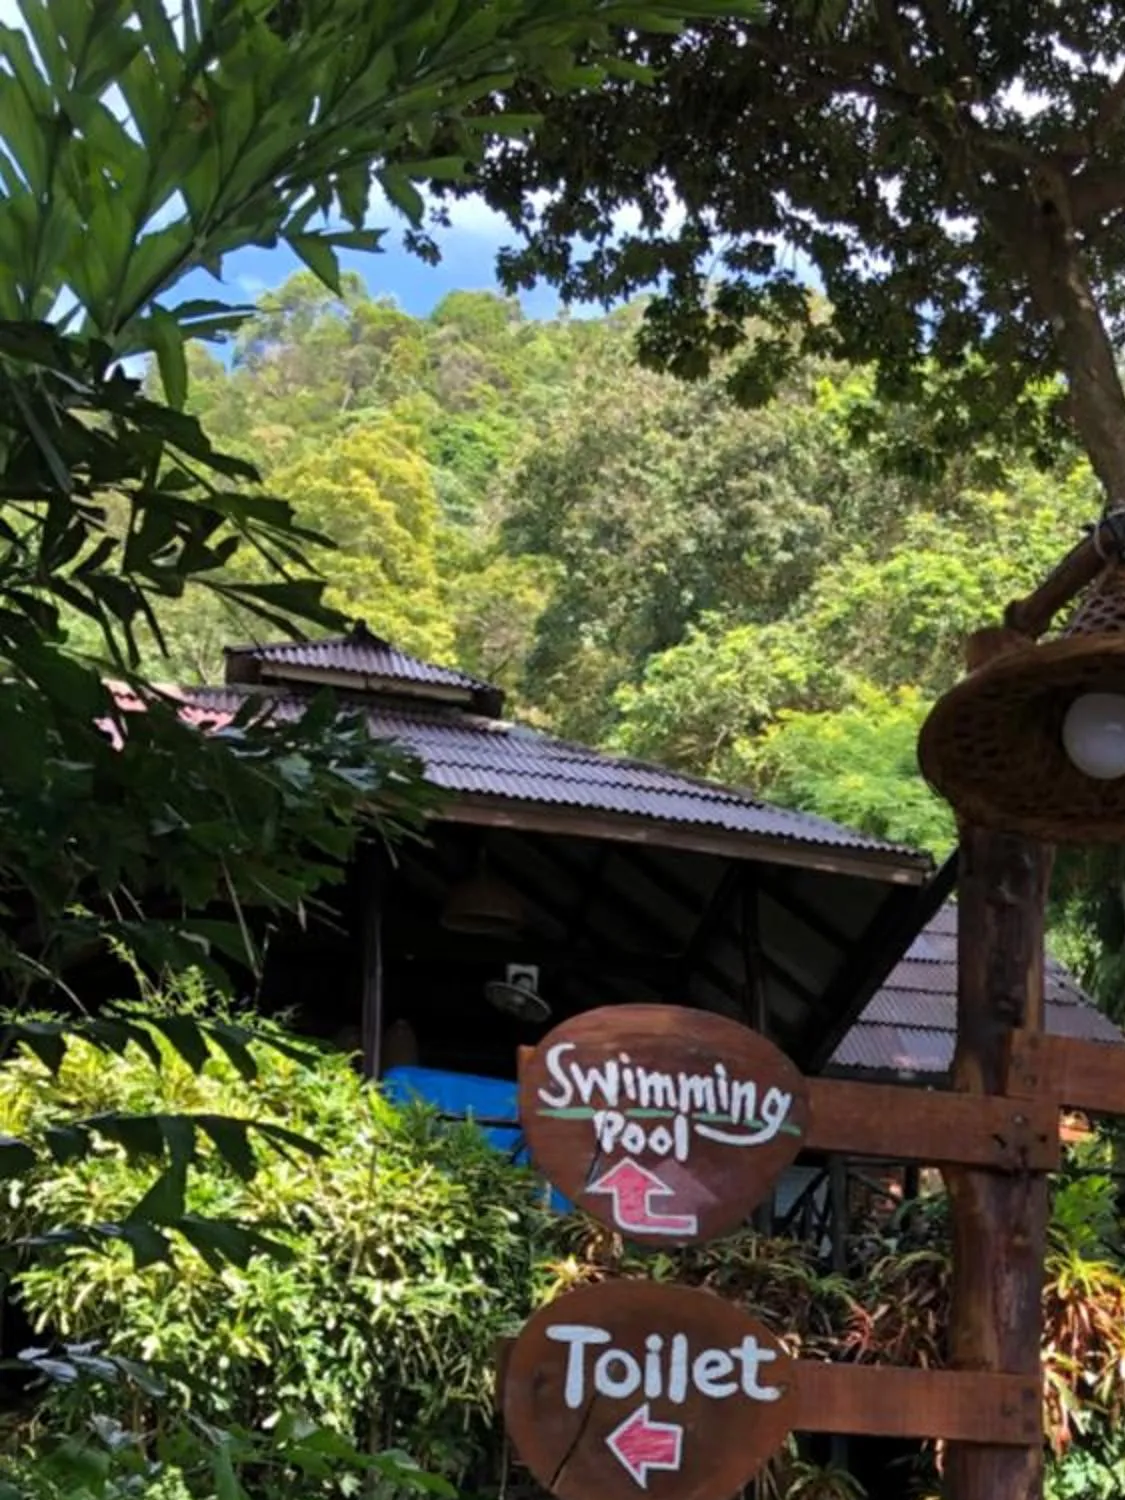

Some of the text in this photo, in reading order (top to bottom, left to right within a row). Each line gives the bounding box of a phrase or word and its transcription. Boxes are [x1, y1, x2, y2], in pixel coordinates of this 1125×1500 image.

[537, 1043, 792, 1146] Swimming
[593, 1110, 689, 1162] Pool
[545, 1324, 782, 1409] Toilet
